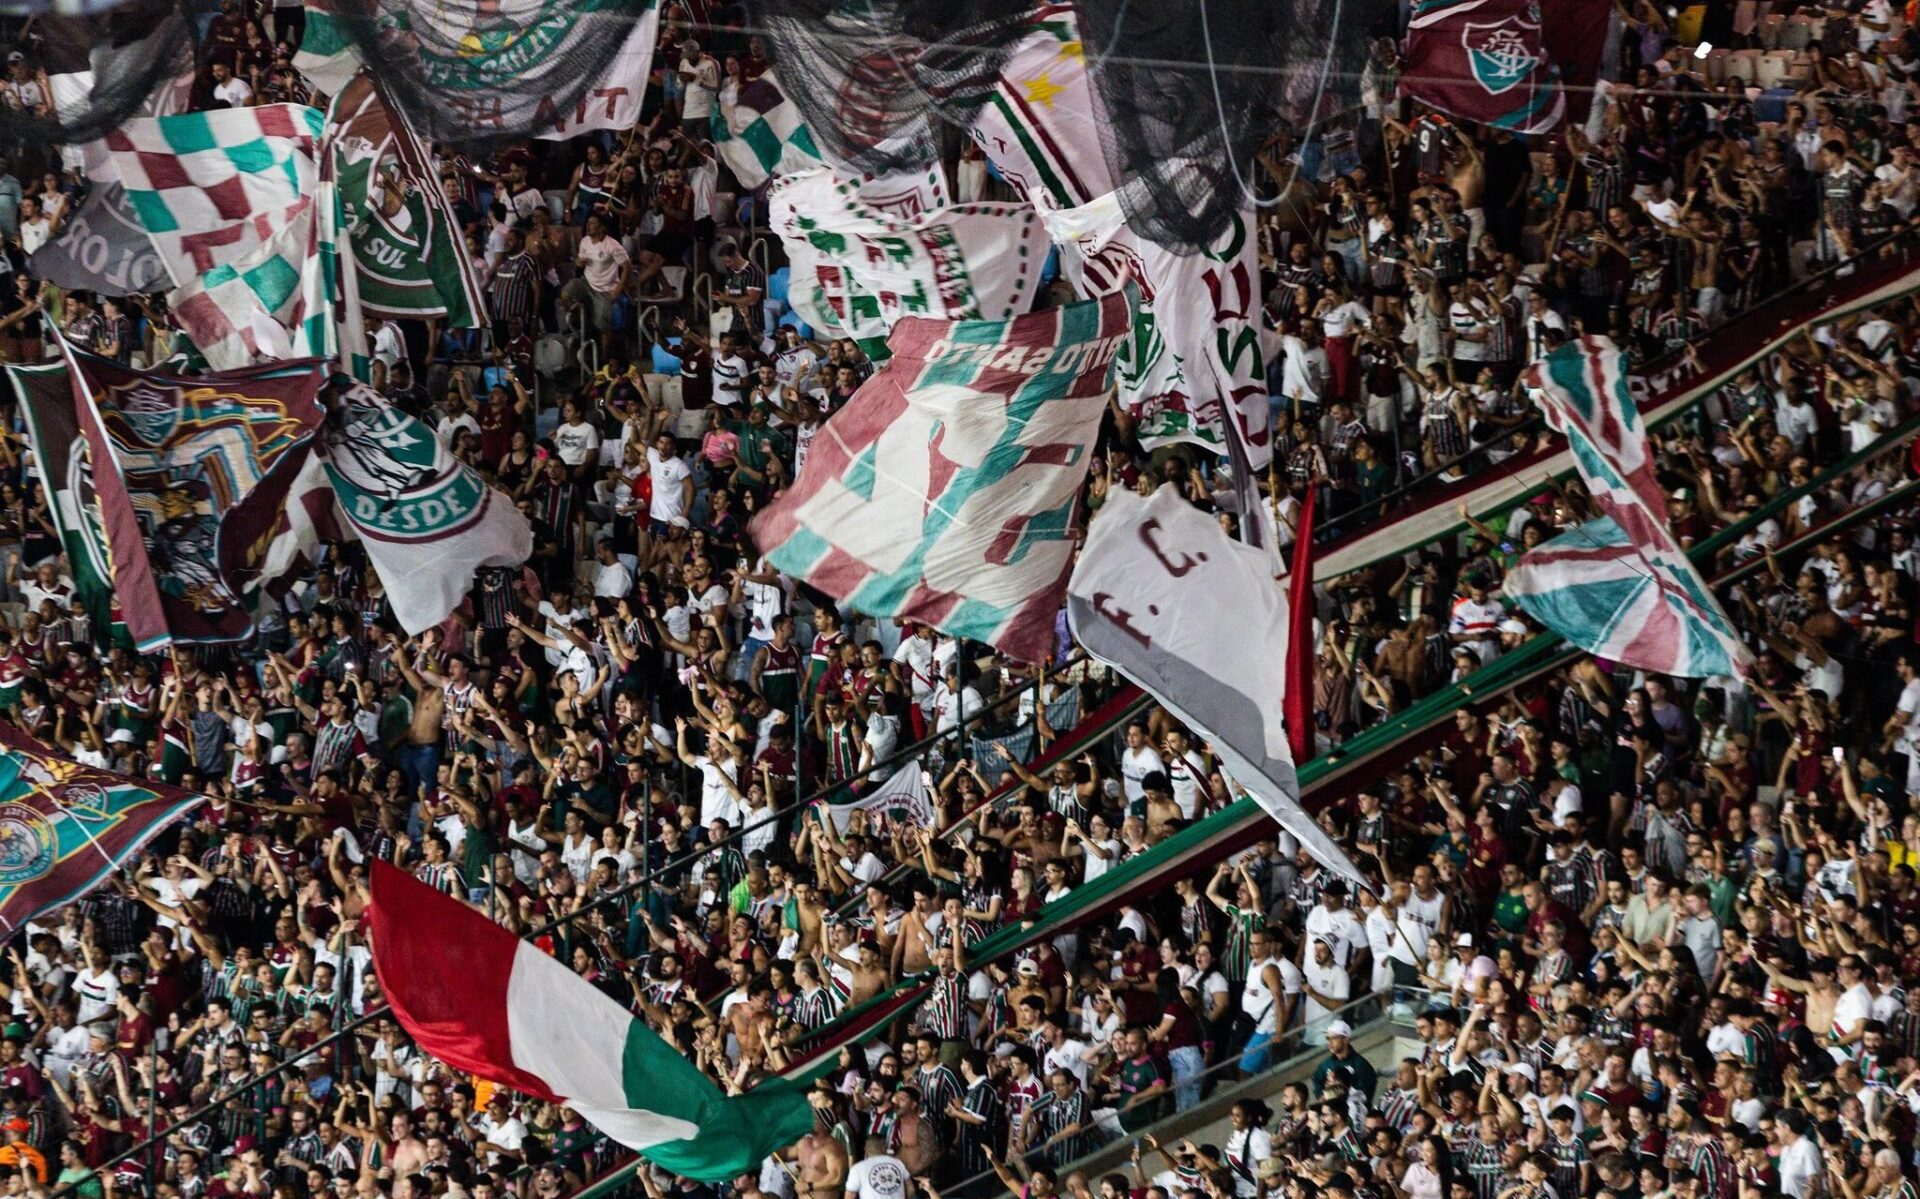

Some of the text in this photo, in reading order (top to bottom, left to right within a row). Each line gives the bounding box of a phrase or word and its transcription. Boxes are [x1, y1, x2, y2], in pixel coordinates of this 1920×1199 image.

[1419, 129, 1431, 153] 9
[363, 238, 408, 269] SUL
[355, 487, 467, 530] DESDE
